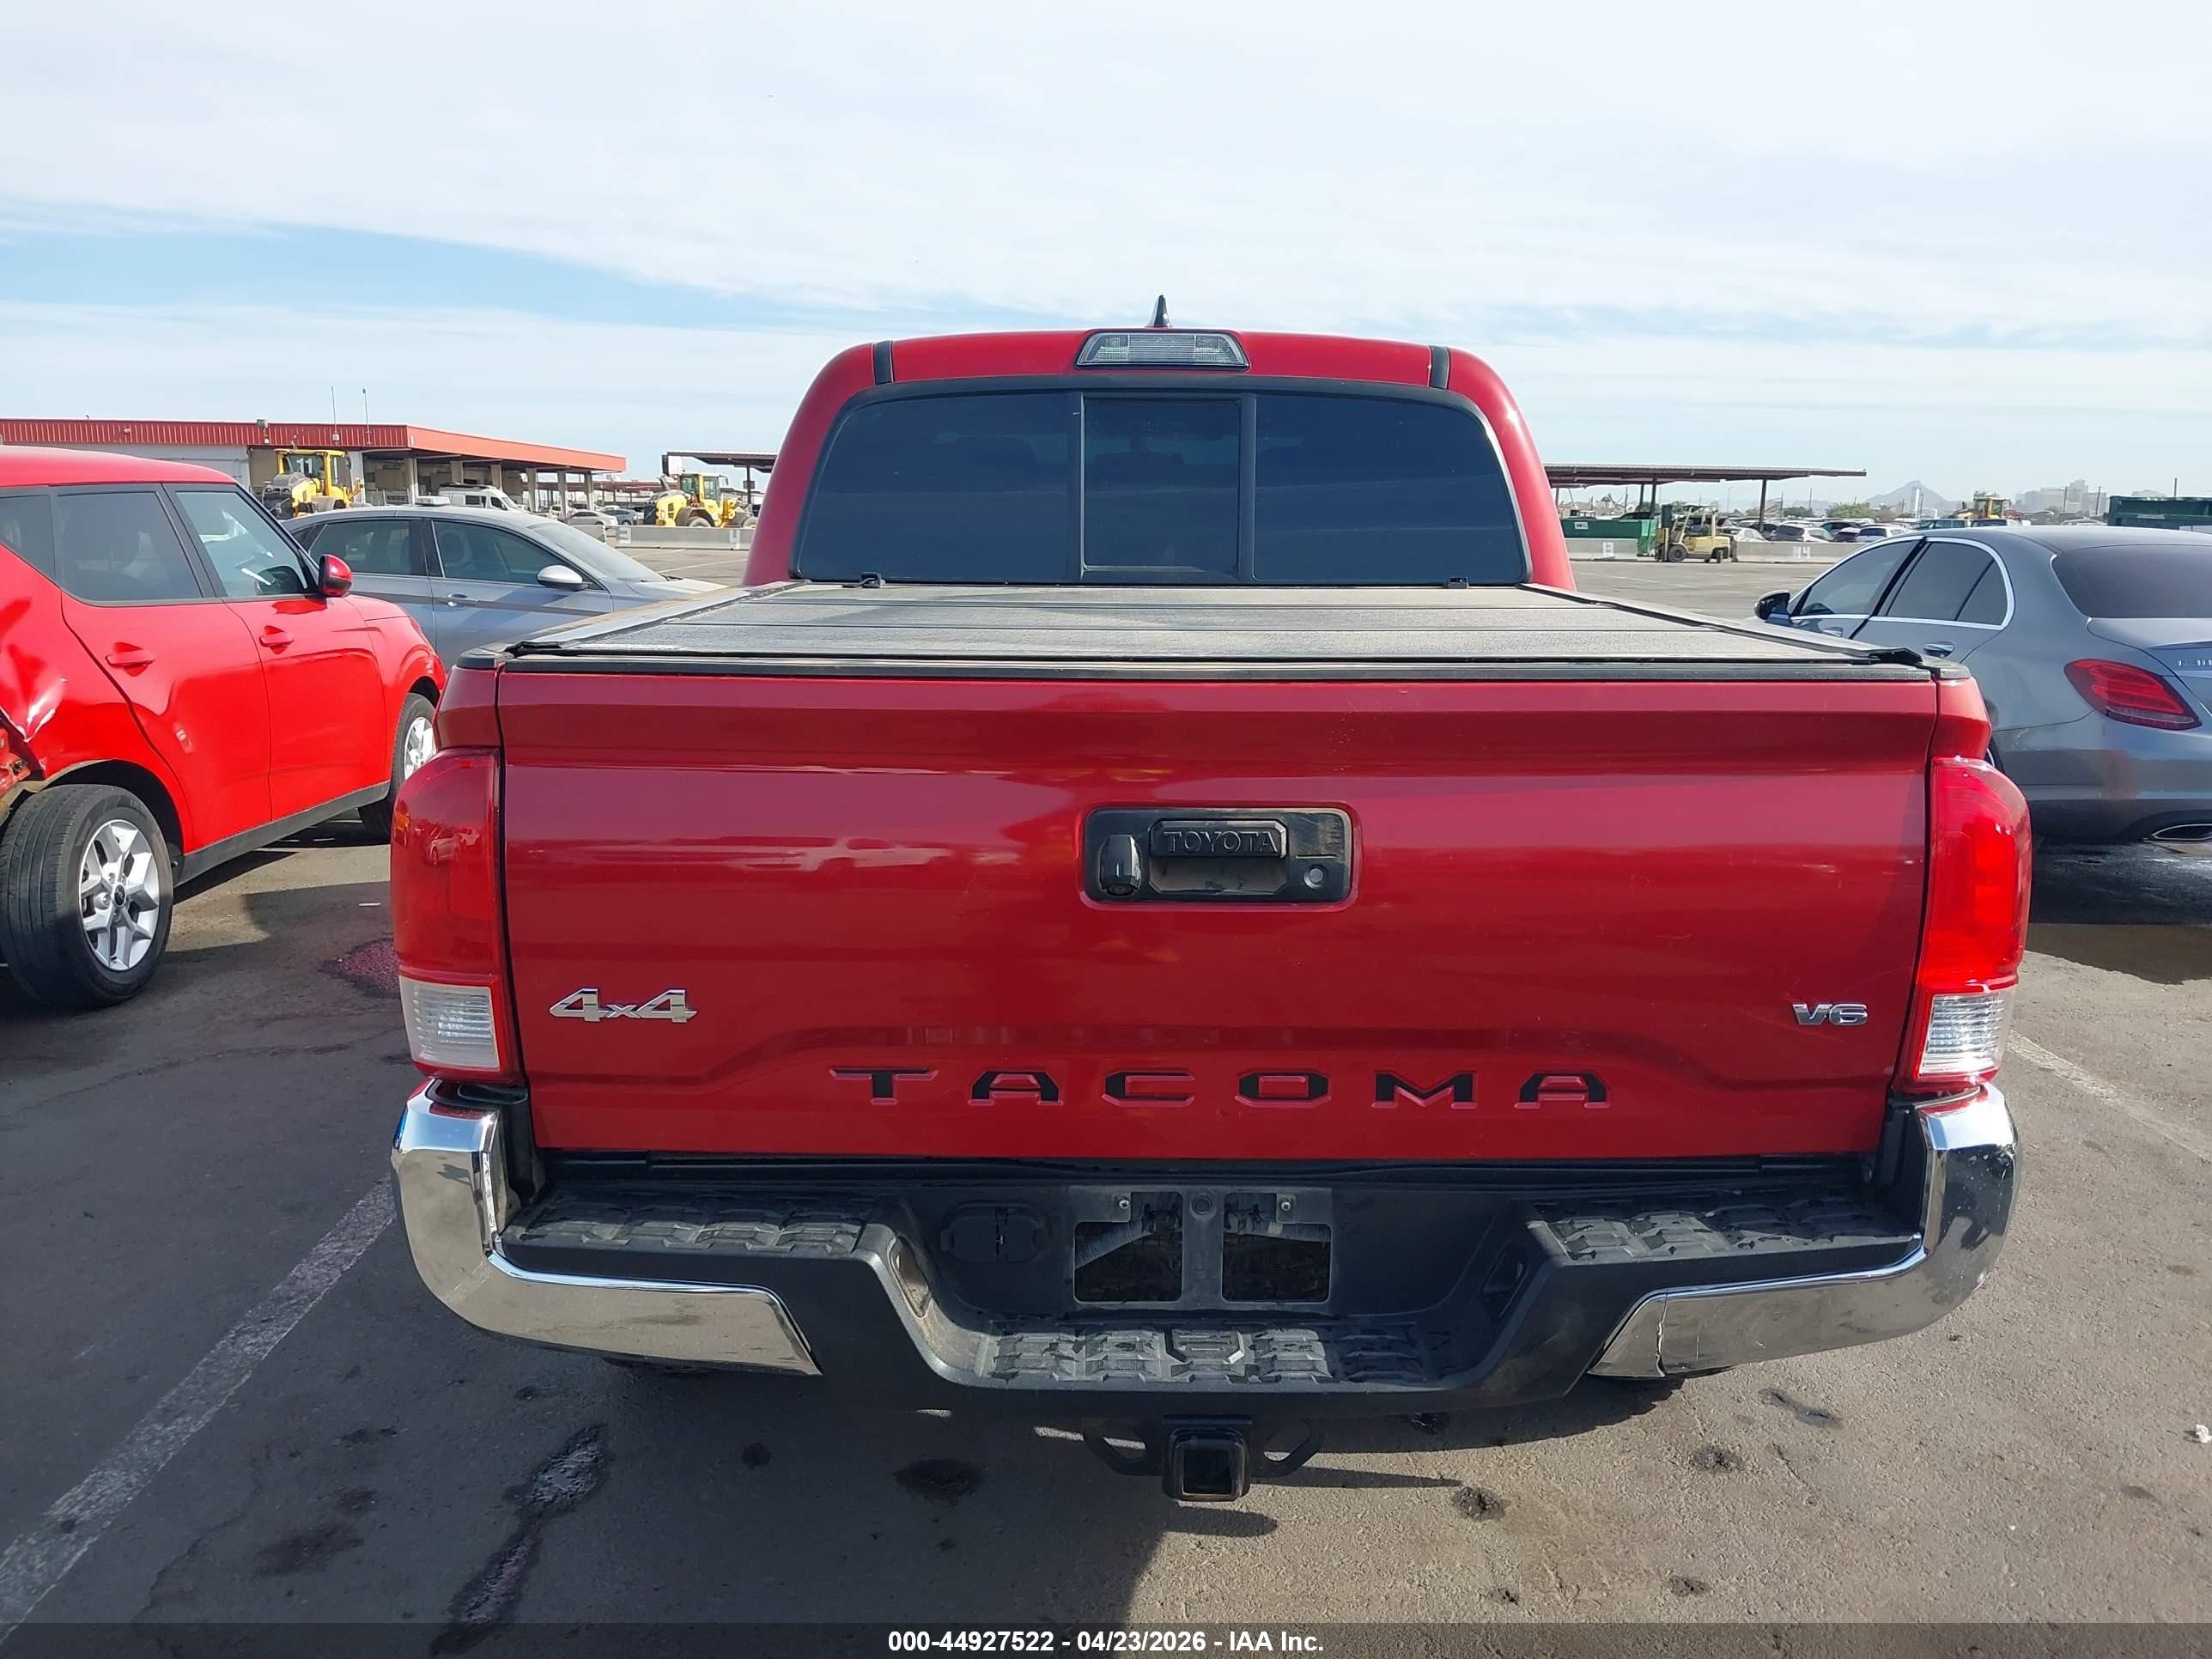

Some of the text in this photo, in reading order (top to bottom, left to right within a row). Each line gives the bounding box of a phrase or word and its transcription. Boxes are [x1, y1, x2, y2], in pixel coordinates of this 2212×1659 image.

[296, 457, 313, 474] 11
[618, 526, 632, 544] 3
[729, 529, 741, 550] 4
[1163, 830, 1278, 853] TOYOTA
[549, 988, 697, 1023] 4x4
[1792, 1003, 1868, 1025] V6
[829, 1067, 1610, 1109] TACOMA
